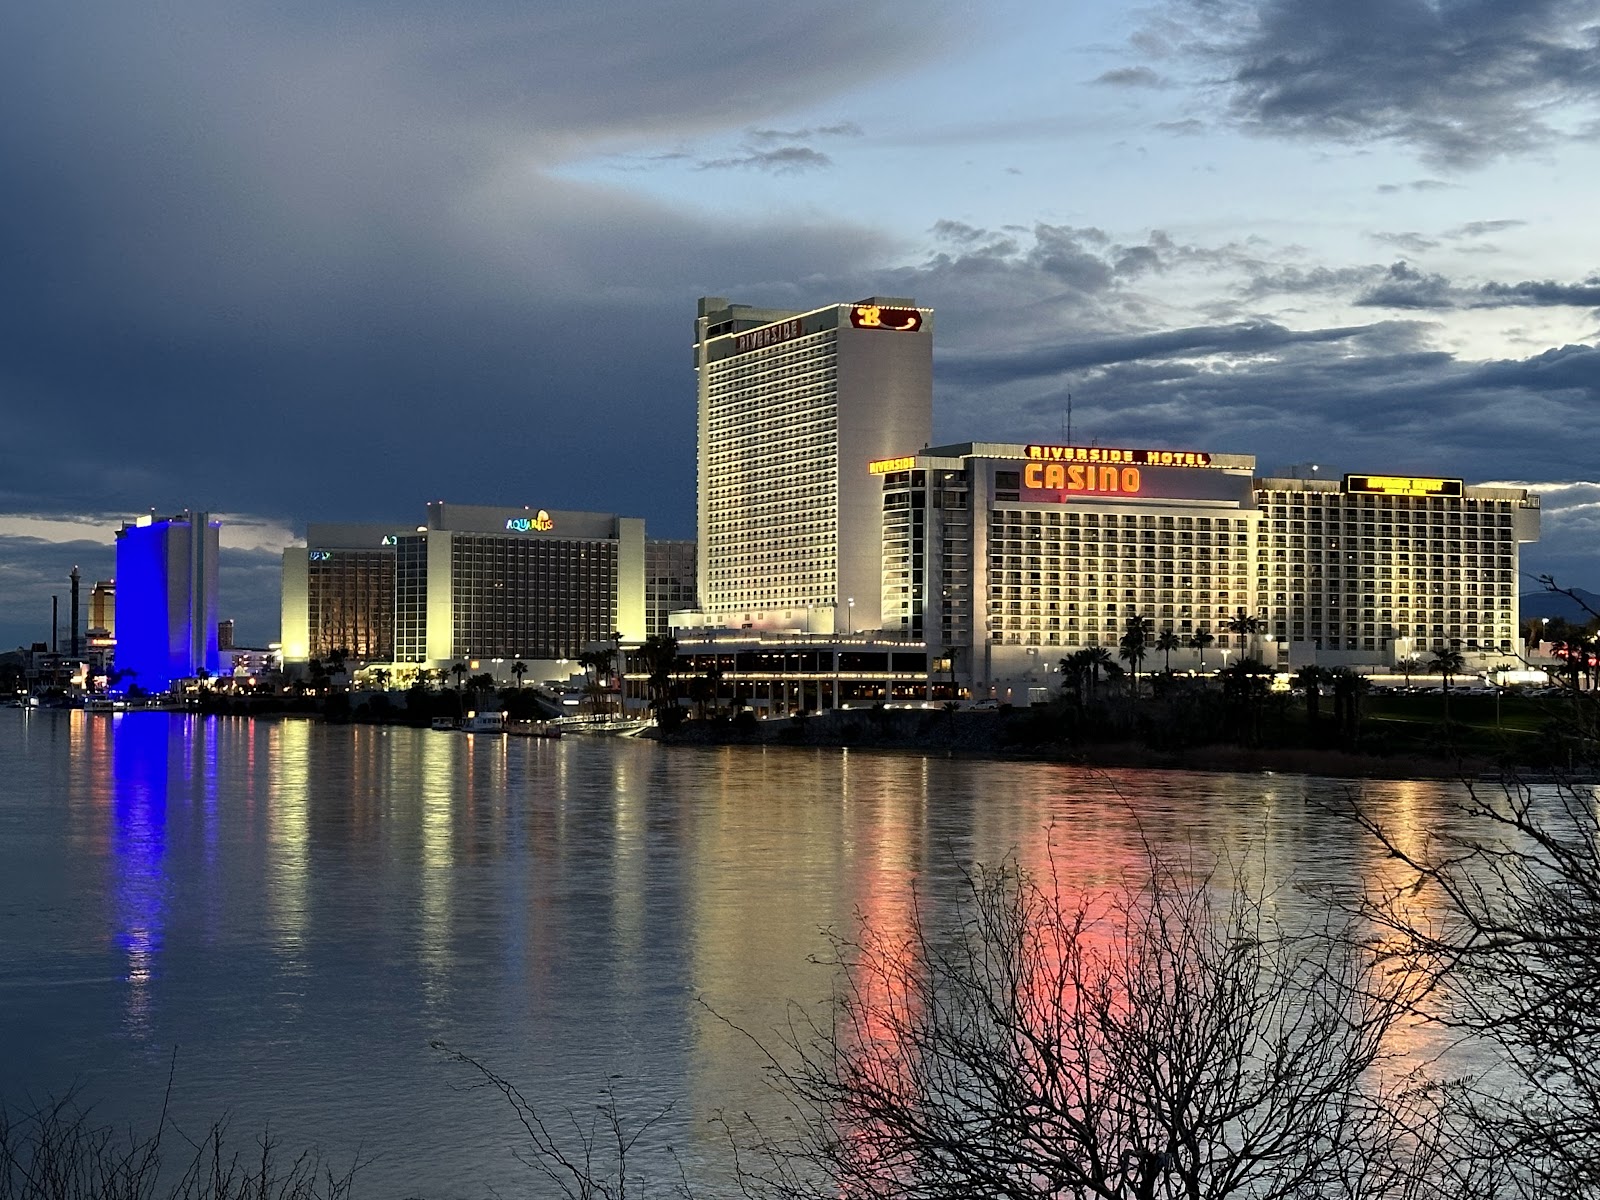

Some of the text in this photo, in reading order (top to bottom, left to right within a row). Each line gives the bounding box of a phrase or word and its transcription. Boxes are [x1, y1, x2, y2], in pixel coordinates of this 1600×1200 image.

[739, 320, 799, 351] RIVERSIDE
[1030, 446, 1207, 464] RIVERSIDE HOTEL
[869, 456, 915, 474] RIVERSIDE
[1025, 463, 1140, 493] CASINO
[506, 518, 554, 531] AQUARIUS
